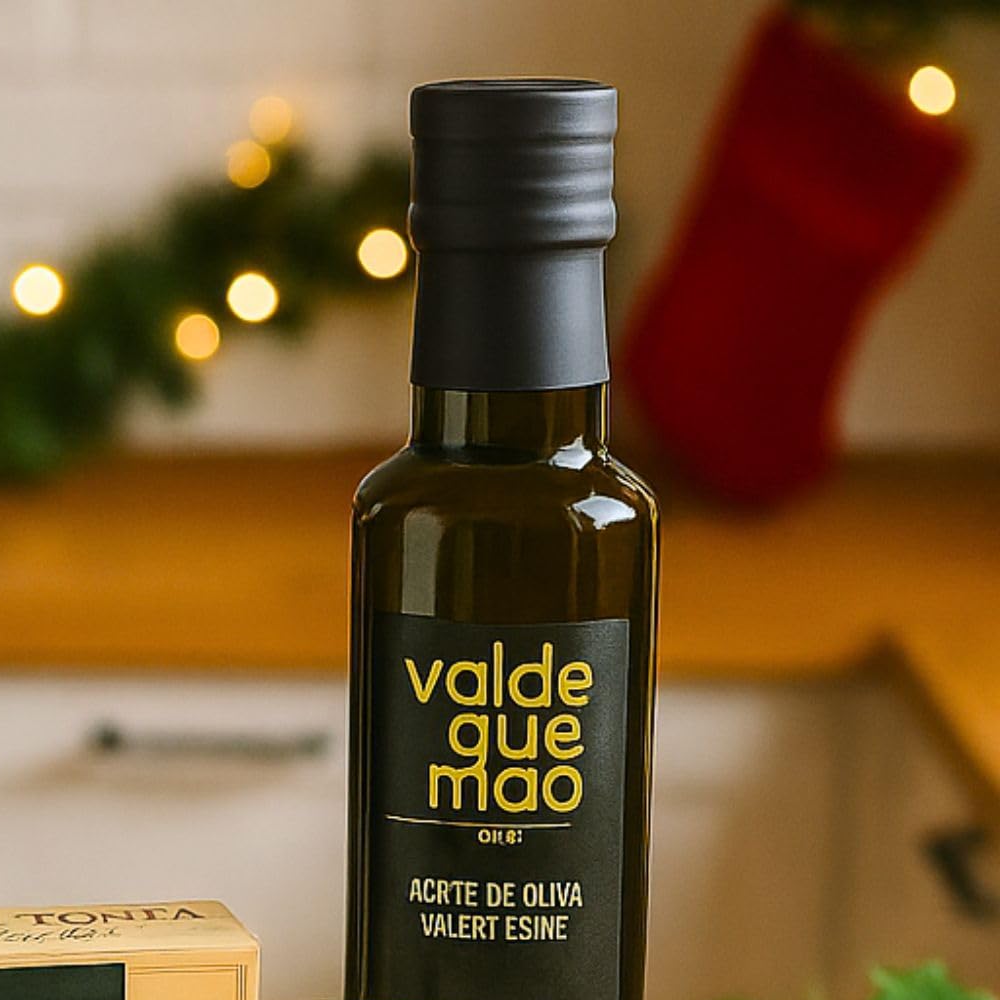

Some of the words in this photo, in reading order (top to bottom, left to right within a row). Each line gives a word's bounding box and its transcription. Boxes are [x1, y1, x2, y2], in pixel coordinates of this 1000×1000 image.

[404, 641, 594, 708] valde
[428, 763, 584, 813] mao
[487, 882, 516, 907] DE
[523, 882, 583, 907] OLIVA
[421, 913, 499, 939] VALERT
[505, 915, 569, 940] ESINE
